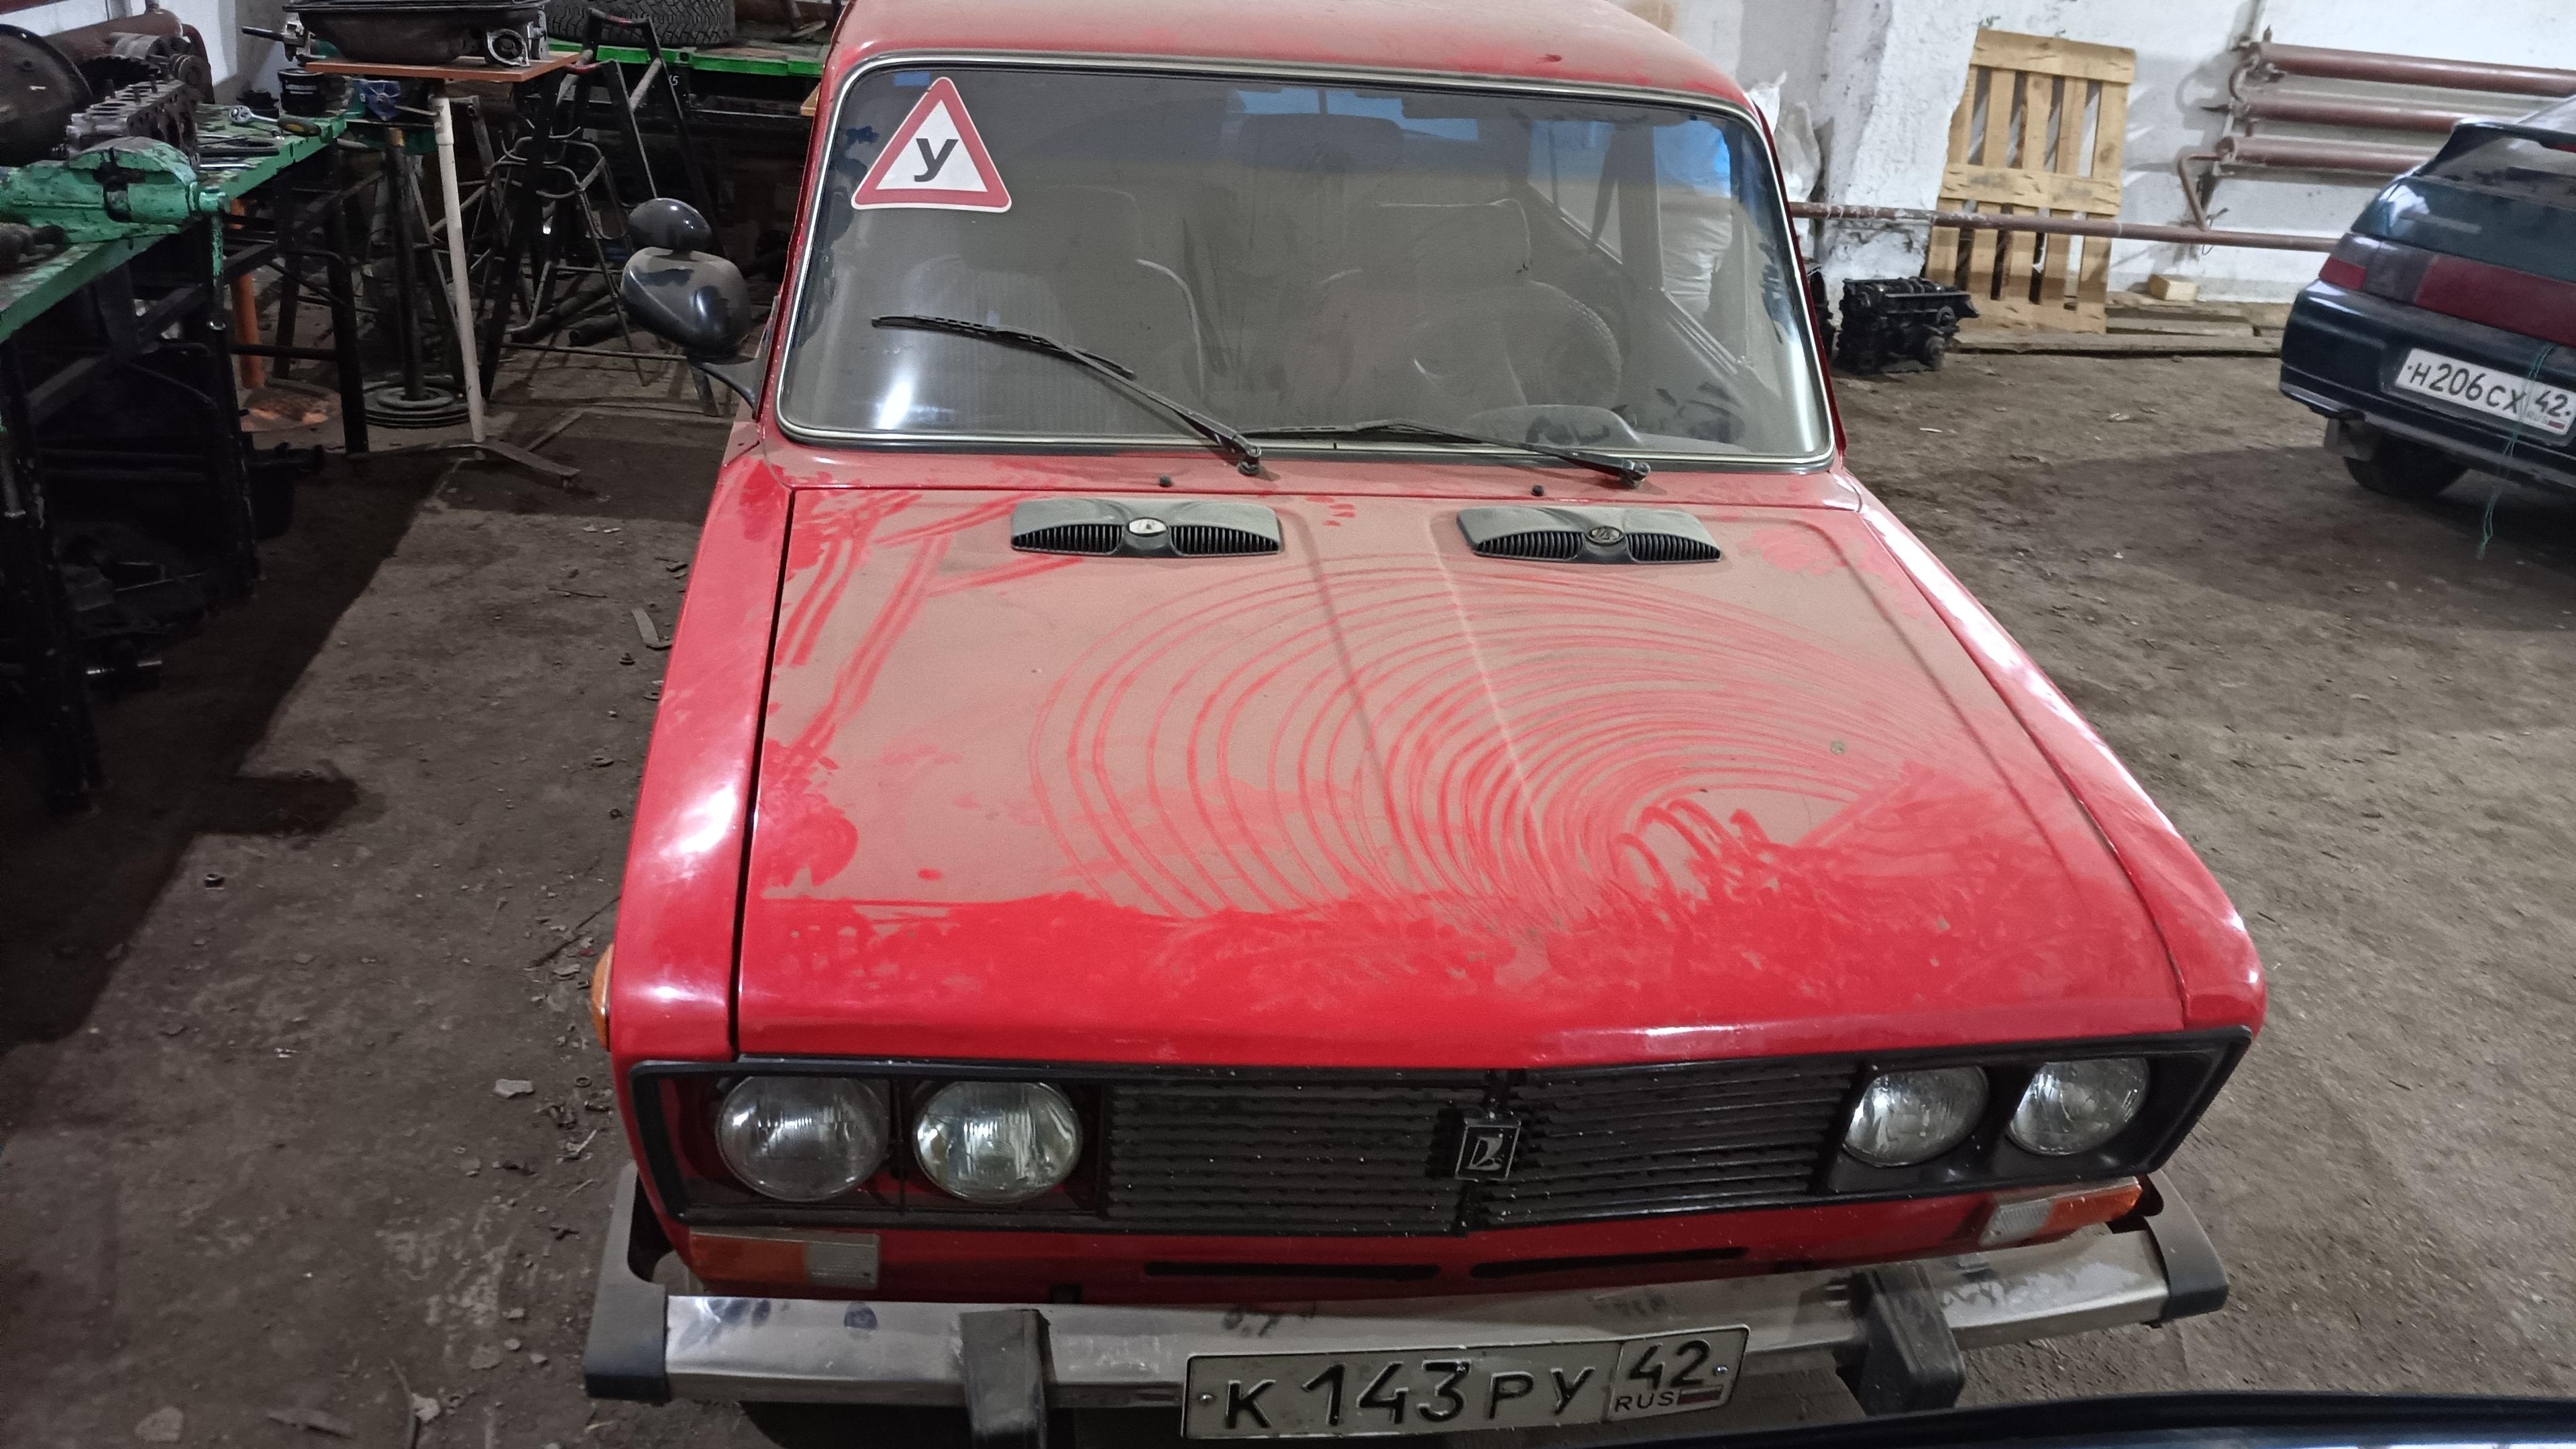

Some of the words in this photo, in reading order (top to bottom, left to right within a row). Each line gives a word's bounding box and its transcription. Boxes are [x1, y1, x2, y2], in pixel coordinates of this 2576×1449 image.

[914, 138, 959, 182] У
[2535, 390, 2569, 417] 42
[1627, 1339, 1711, 1390] 42
[1615, 1391, 1674, 1412] RUS
